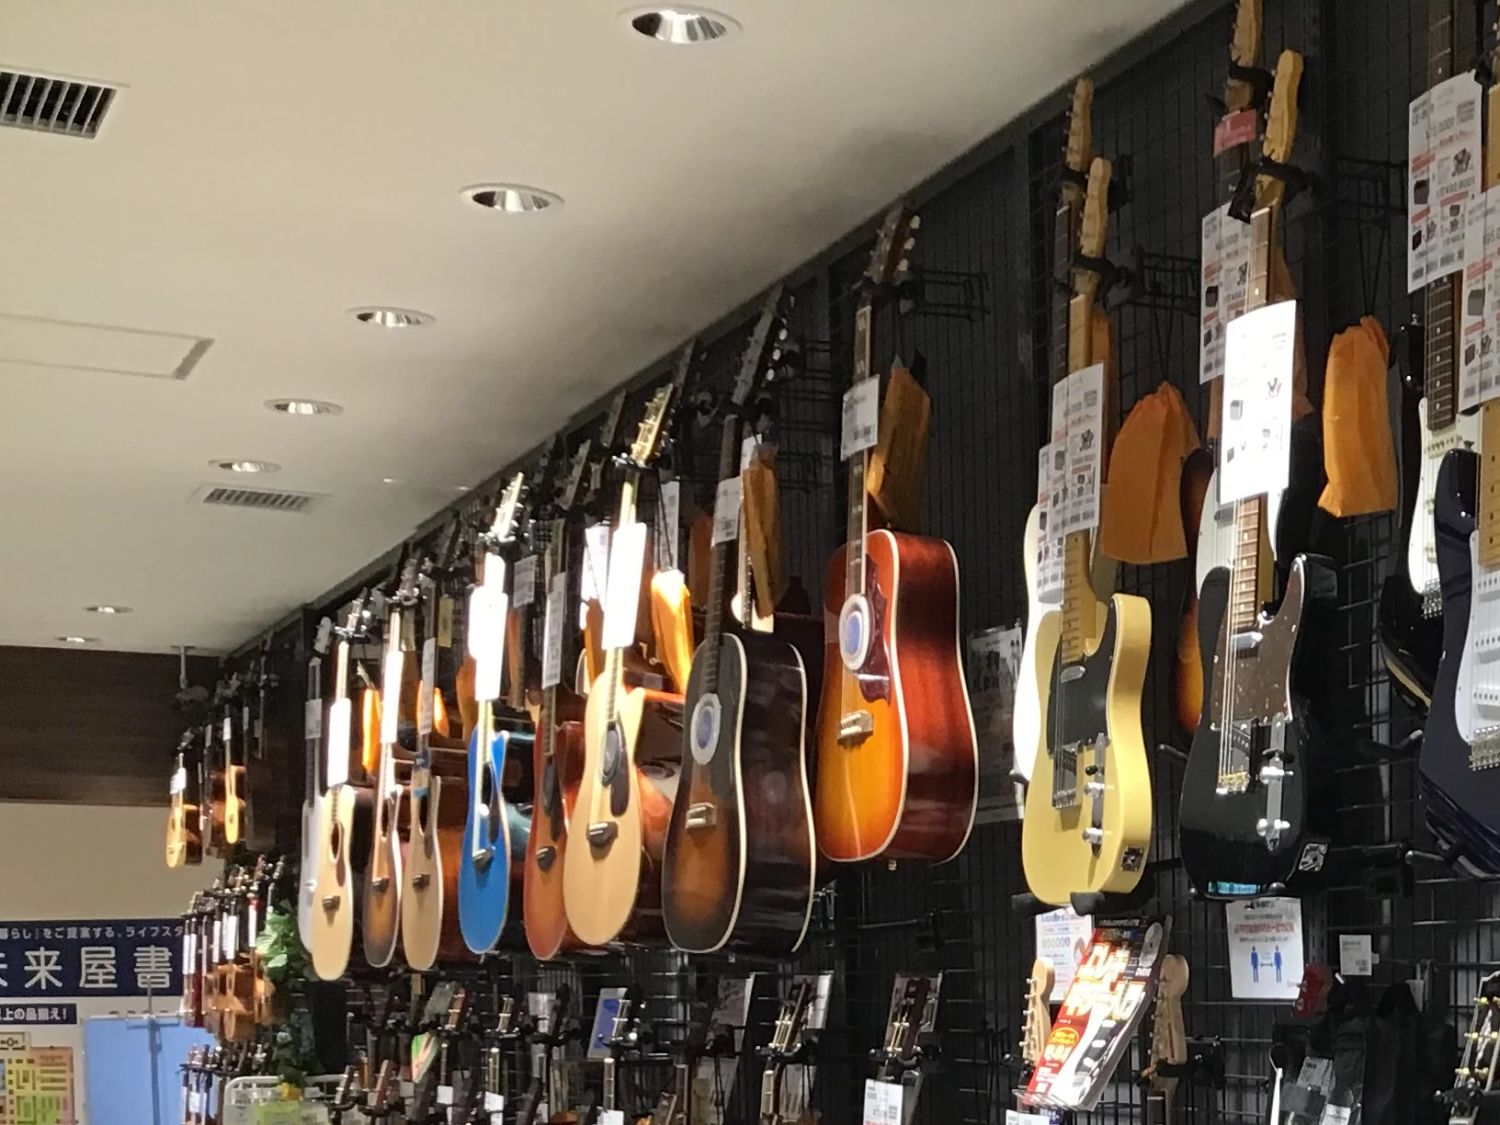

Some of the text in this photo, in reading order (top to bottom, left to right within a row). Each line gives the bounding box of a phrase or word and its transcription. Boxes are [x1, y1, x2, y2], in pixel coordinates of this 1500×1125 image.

[0, 946, 173, 990] 来屋書
[0, 1007, 67, 1021] 上の品揃え!
